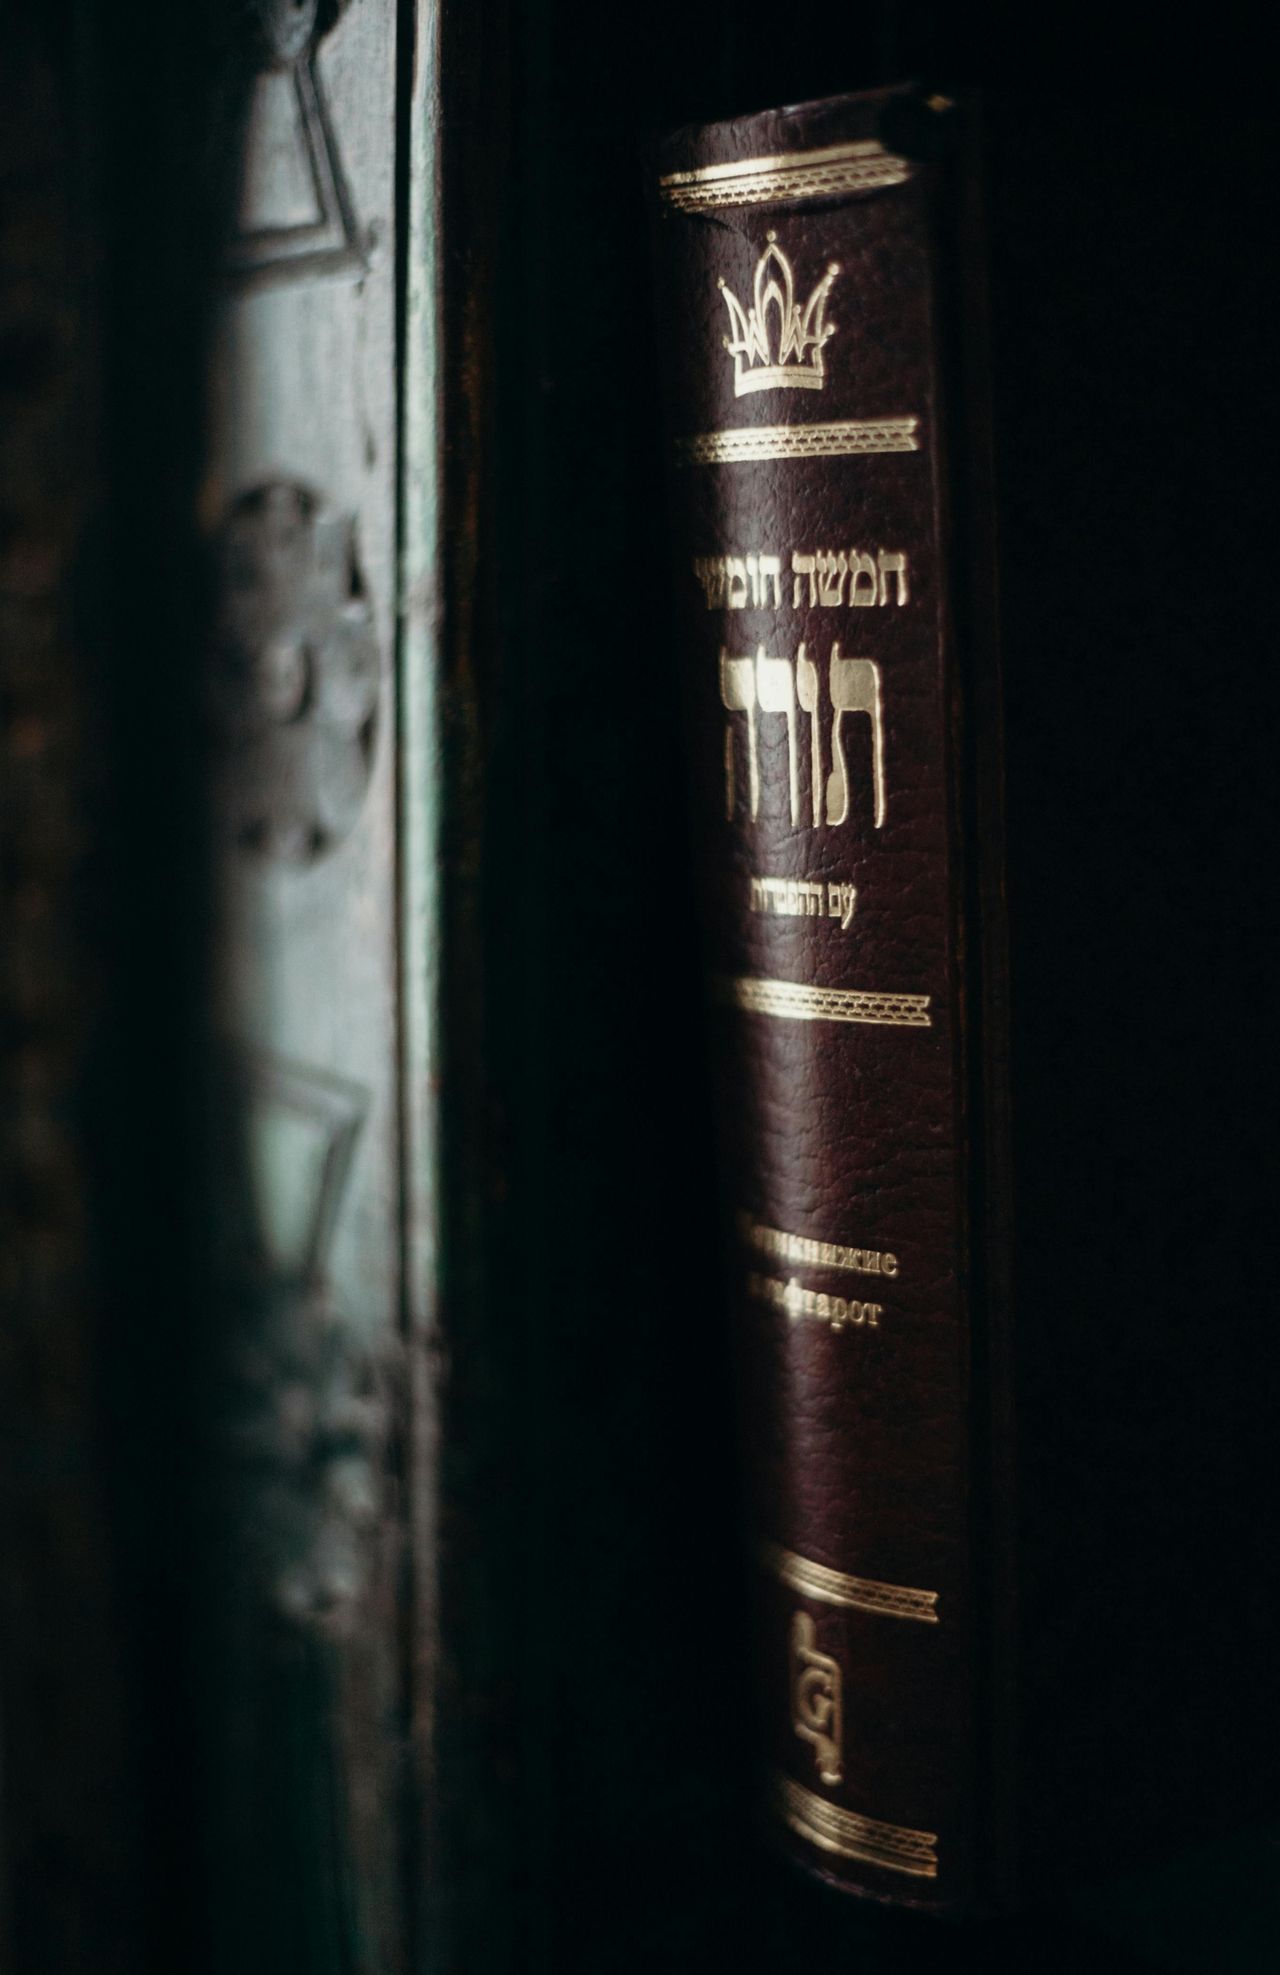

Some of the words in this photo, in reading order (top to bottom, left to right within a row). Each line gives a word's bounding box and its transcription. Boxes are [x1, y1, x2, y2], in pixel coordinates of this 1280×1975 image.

[792, 549, 908, 607] חמשה
[719, 642, 885, 829] תורה
[827, 882, 857, 930] עם
